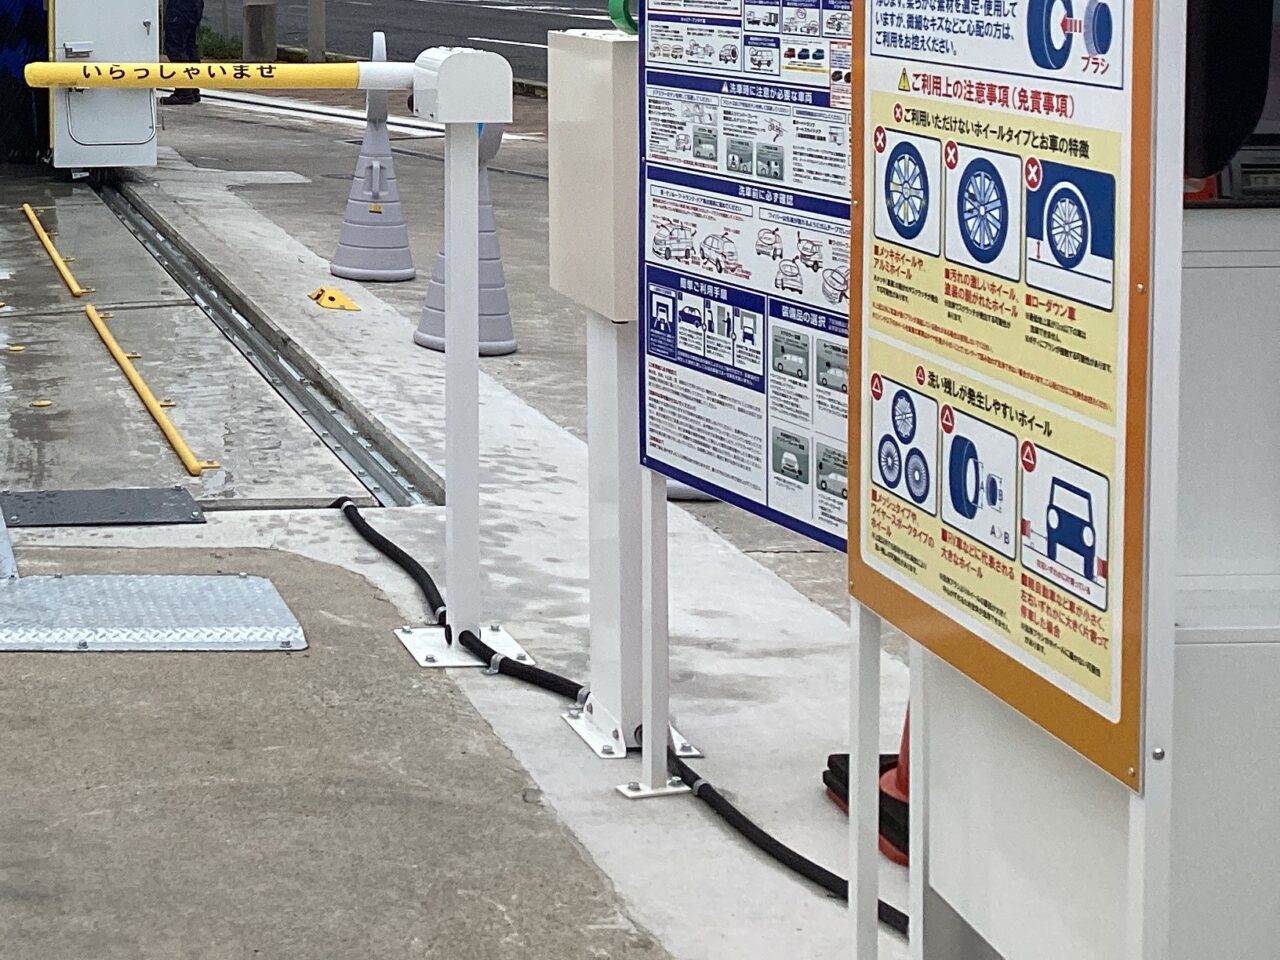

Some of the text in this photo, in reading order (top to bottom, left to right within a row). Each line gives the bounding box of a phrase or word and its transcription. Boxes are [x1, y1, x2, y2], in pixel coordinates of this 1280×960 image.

[82, 63, 277, 80] いらっしゃいませ
[1081, 55, 1109, 75] ブラシ
[874, 258, 912, 280] アルミホイール
[927, 371, 1052, 436] 洗い残しが発生しやすいホイール
[871, 518, 892, 537] ホイール
[940, 547, 983, 579] 大きなホイール
